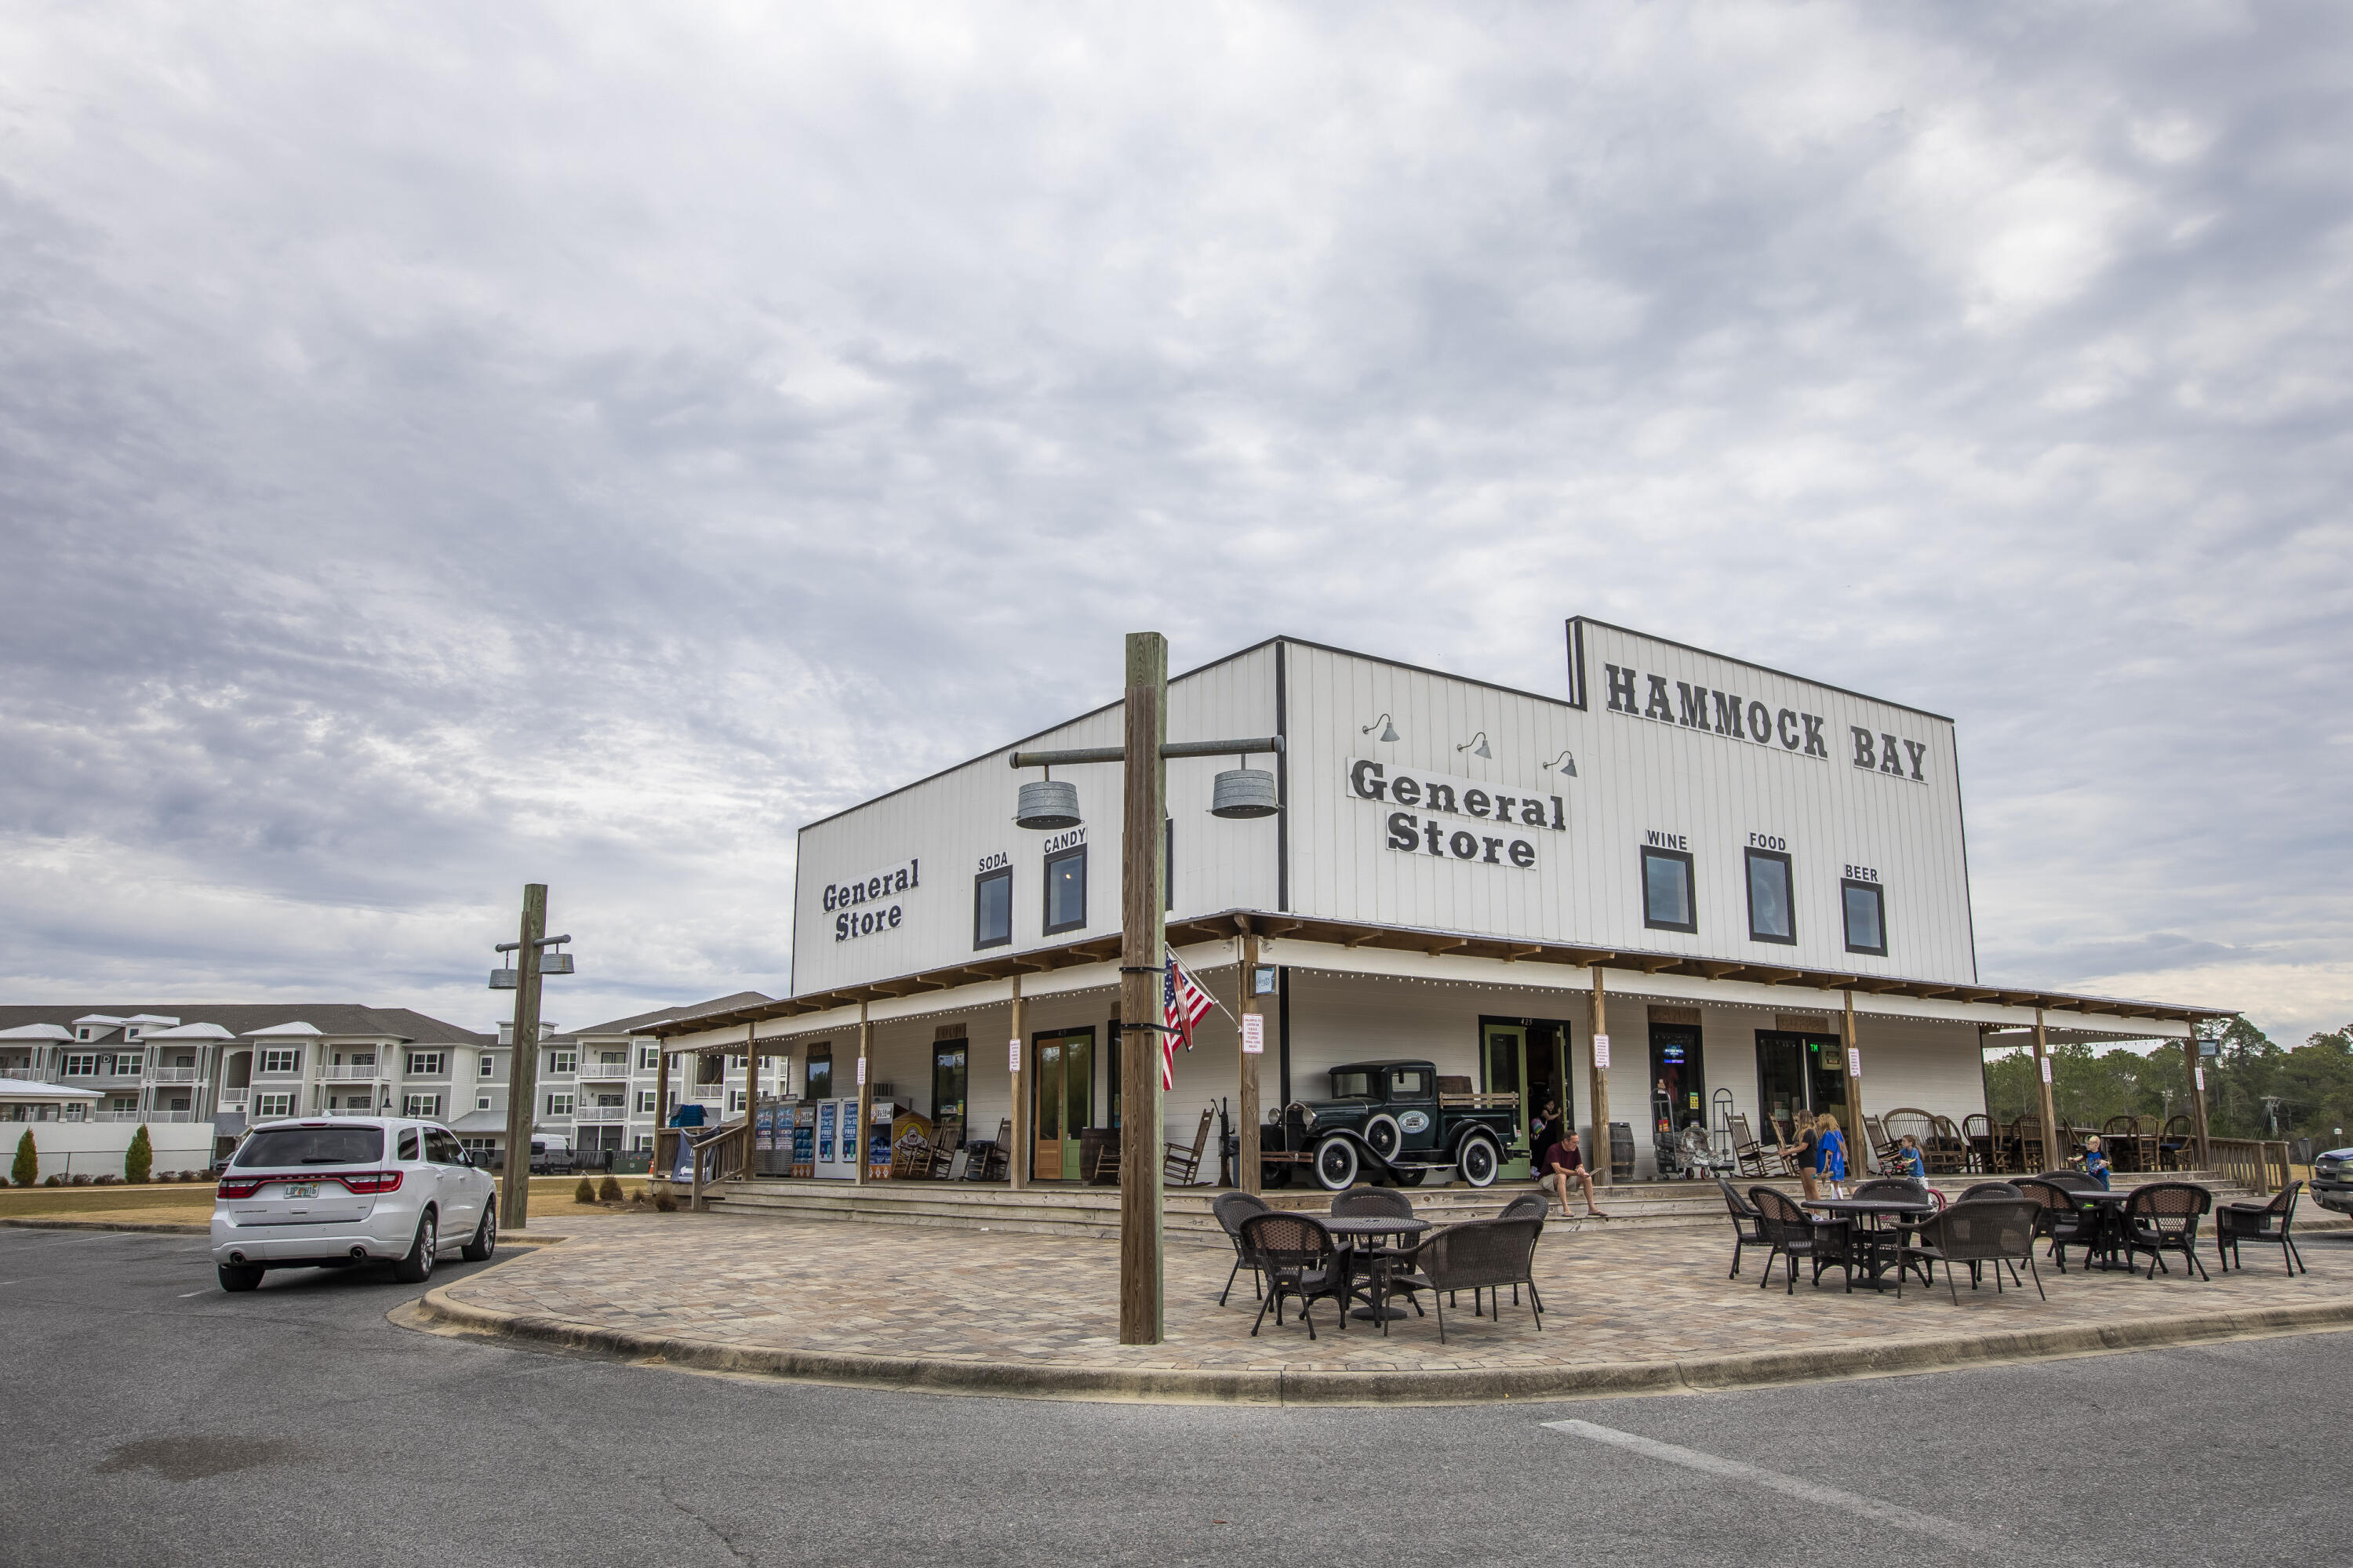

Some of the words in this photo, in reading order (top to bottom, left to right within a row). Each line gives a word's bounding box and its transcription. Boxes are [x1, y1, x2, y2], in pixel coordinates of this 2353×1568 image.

[1605, 663, 1828, 759] HAMMOCK
[1850, 726, 1927, 783] BAY
[1350, 759, 1567, 831] General
[1044, 827, 1086, 853] CANDY
[1387, 812, 1536, 869] Store
[1647, 830, 1687, 851] WINE
[1750, 832, 1786, 851] FOOD
[978, 851, 1008, 872] SODA
[1845, 864, 1878, 882] BEER
[823, 858, 919, 912] General
[835, 905, 902, 942] Store
